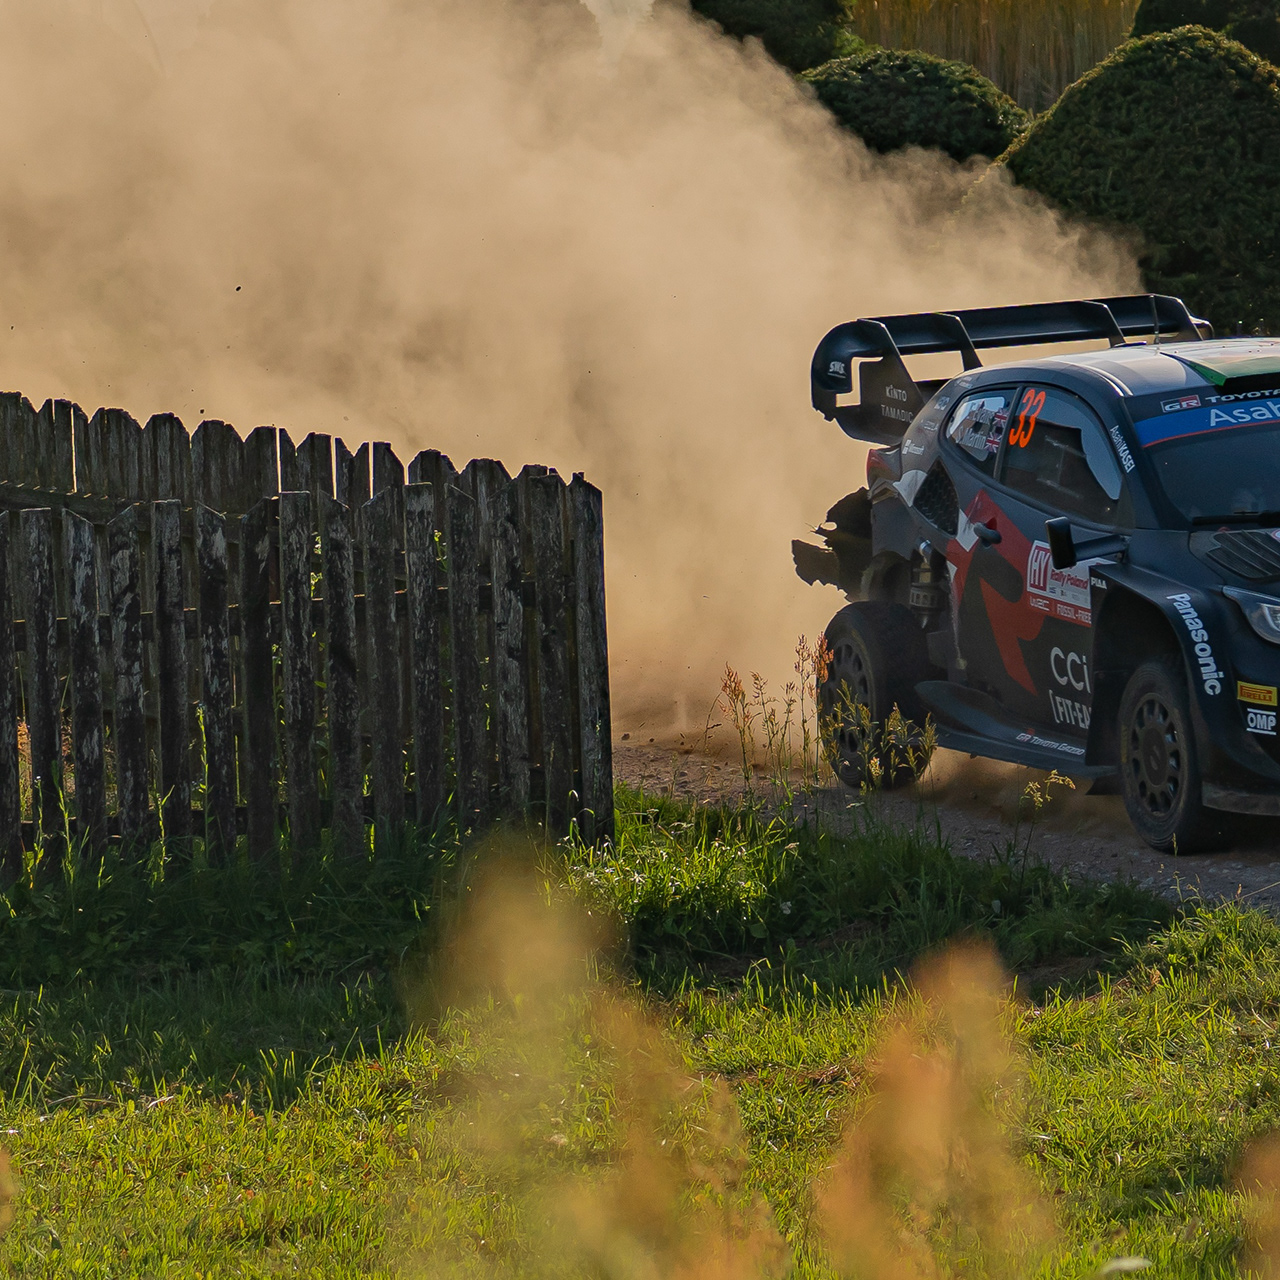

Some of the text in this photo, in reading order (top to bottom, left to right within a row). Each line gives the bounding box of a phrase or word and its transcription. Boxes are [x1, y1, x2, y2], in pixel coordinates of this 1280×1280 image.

[1163, 398, 1199, 411] GR
[1009, 389, 1046, 448] 33
[1110, 424, 1136, 473] AsahiKASEI
[1166, 592, 1225, 696] Panasonic
[1240, 685, 1273, 702] PIRELLI
[1247, 713, 1277, 731] OMP
[1030, 736, 1059, 749] TOYOTA
